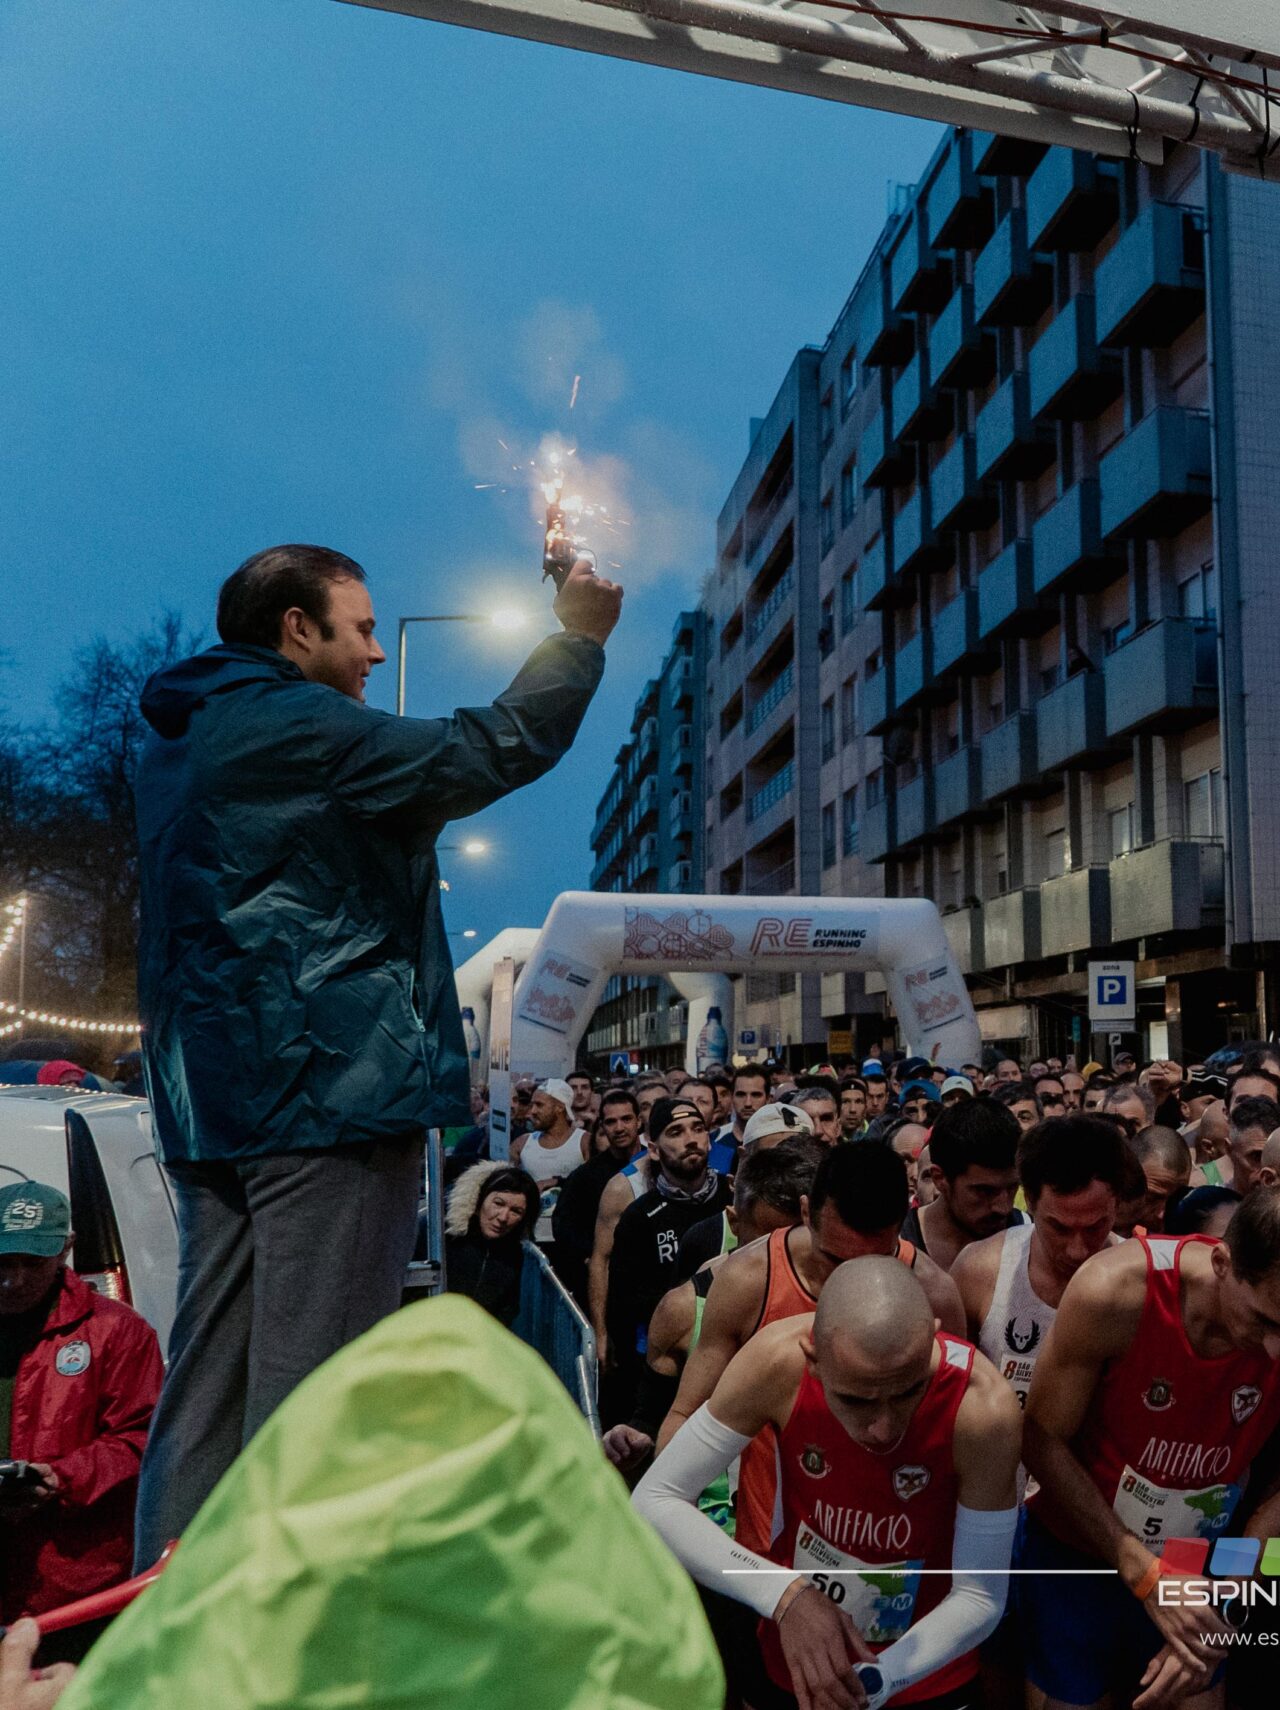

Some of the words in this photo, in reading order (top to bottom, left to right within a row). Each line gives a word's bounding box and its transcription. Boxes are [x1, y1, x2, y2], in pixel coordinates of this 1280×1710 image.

[753, 917, 812, 957] RE
[815, 929, 867, 938] RUNNING
[813, 940, 862, 949] ESPINHO
[1103, 979, 1121, 1002] P
[657, 1229, 678, 1245] DR.
[1143, 1517, 1163, 1536] 5
[812, 1573, 847, 1605] 50
